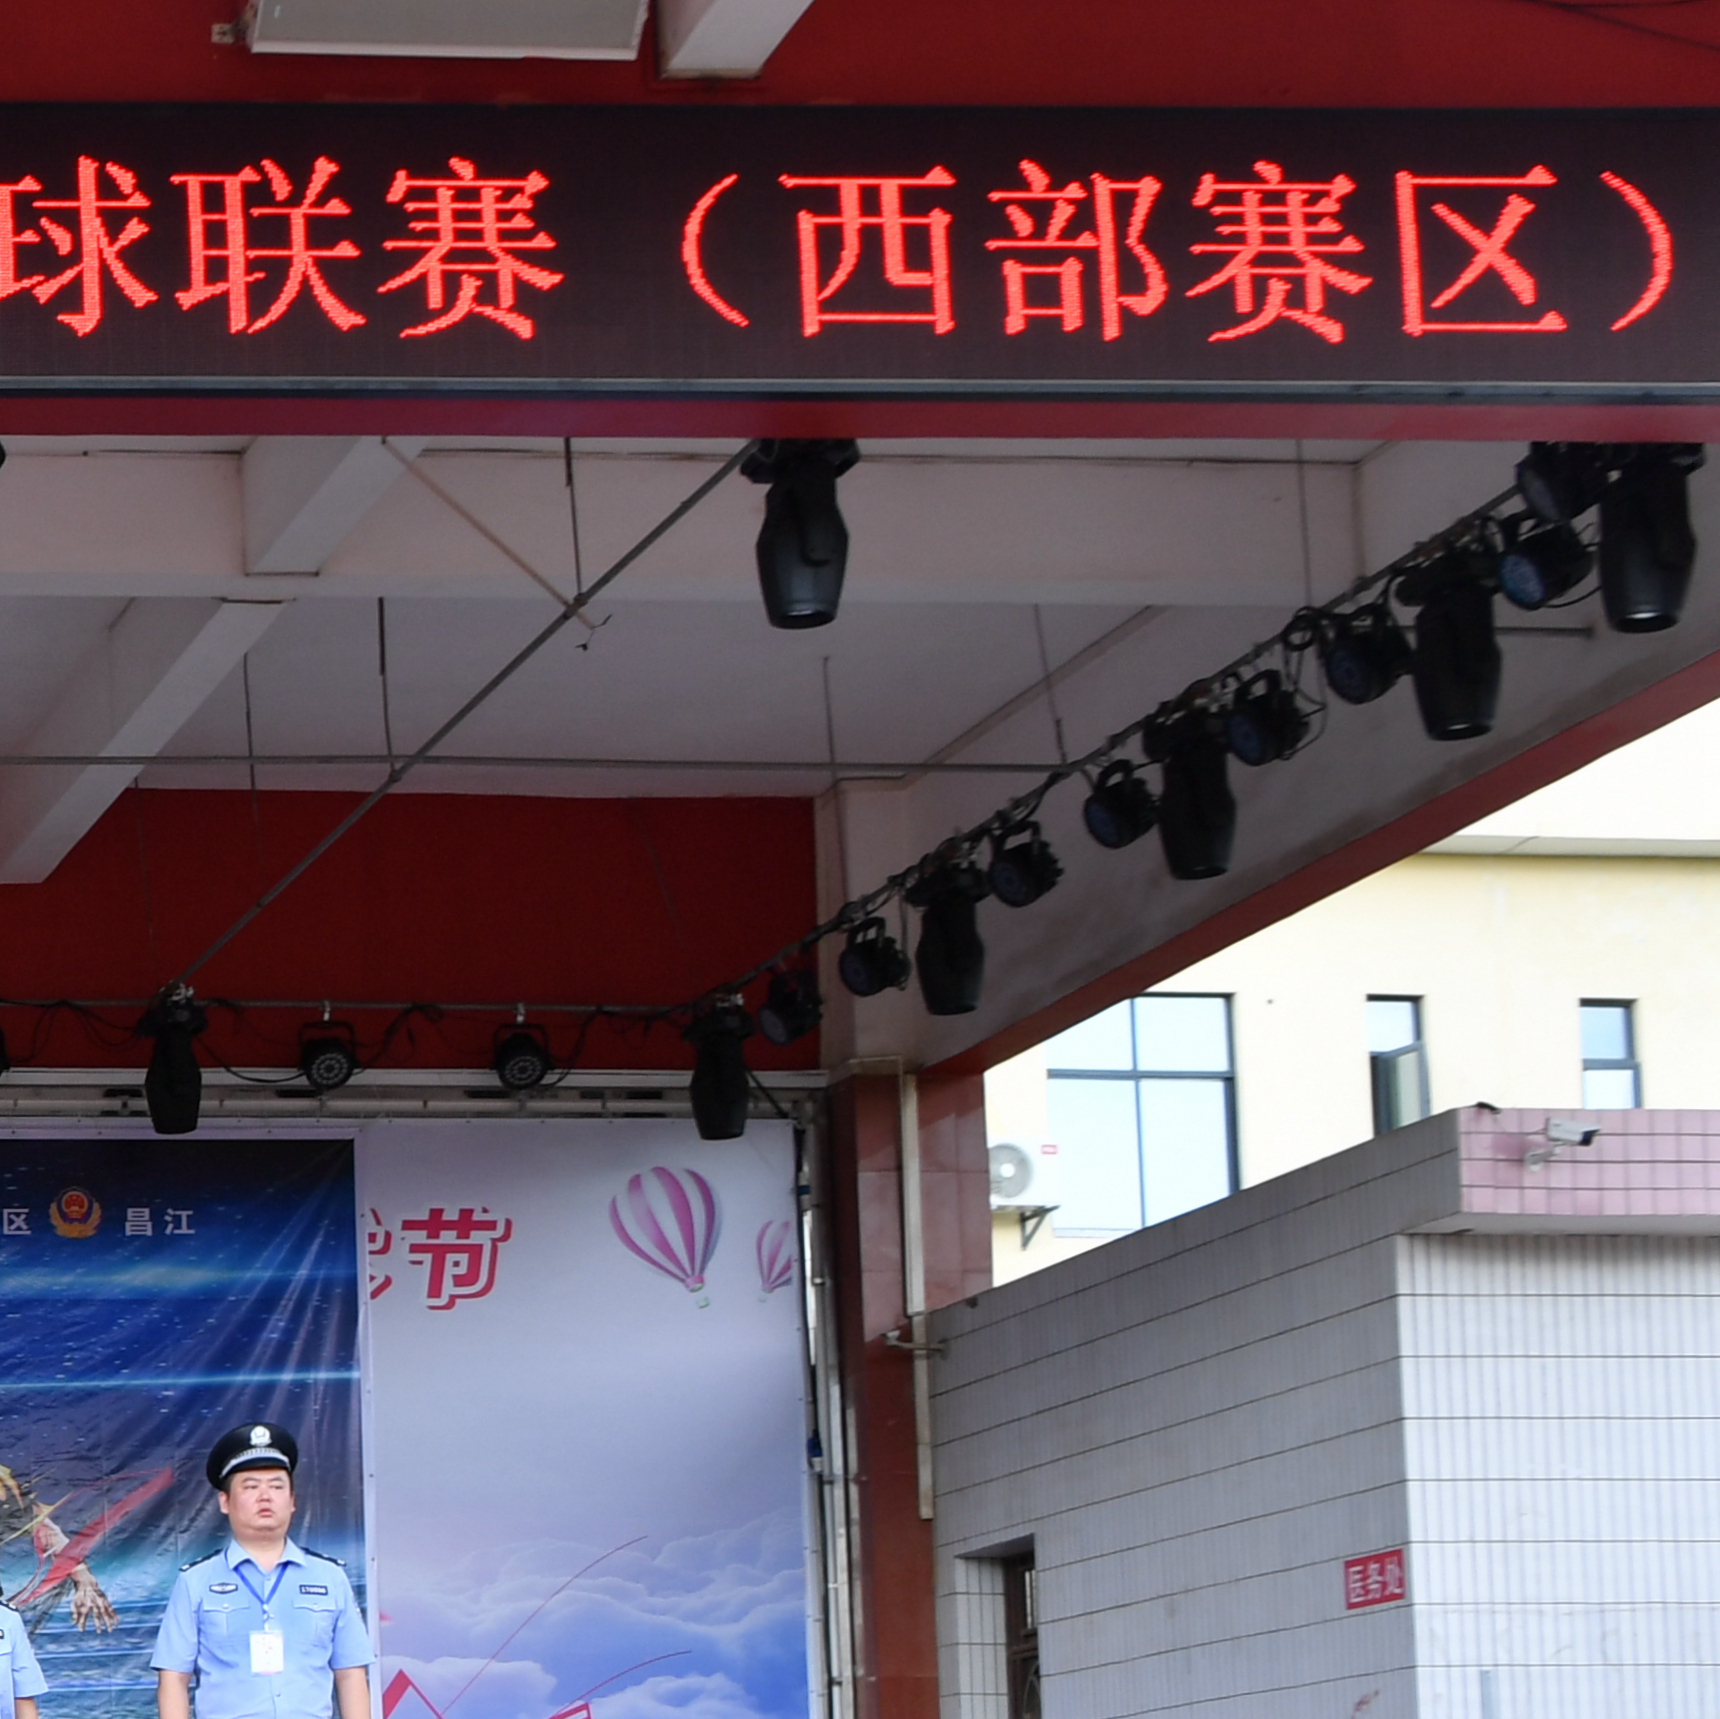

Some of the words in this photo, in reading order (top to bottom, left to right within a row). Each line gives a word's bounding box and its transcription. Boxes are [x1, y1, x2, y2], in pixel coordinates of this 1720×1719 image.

[124, 1207, 196, 1236] 昌江
[368, 1207, 513, 1310] 节
[1348, 1556, 1403, 1603] 医务处
